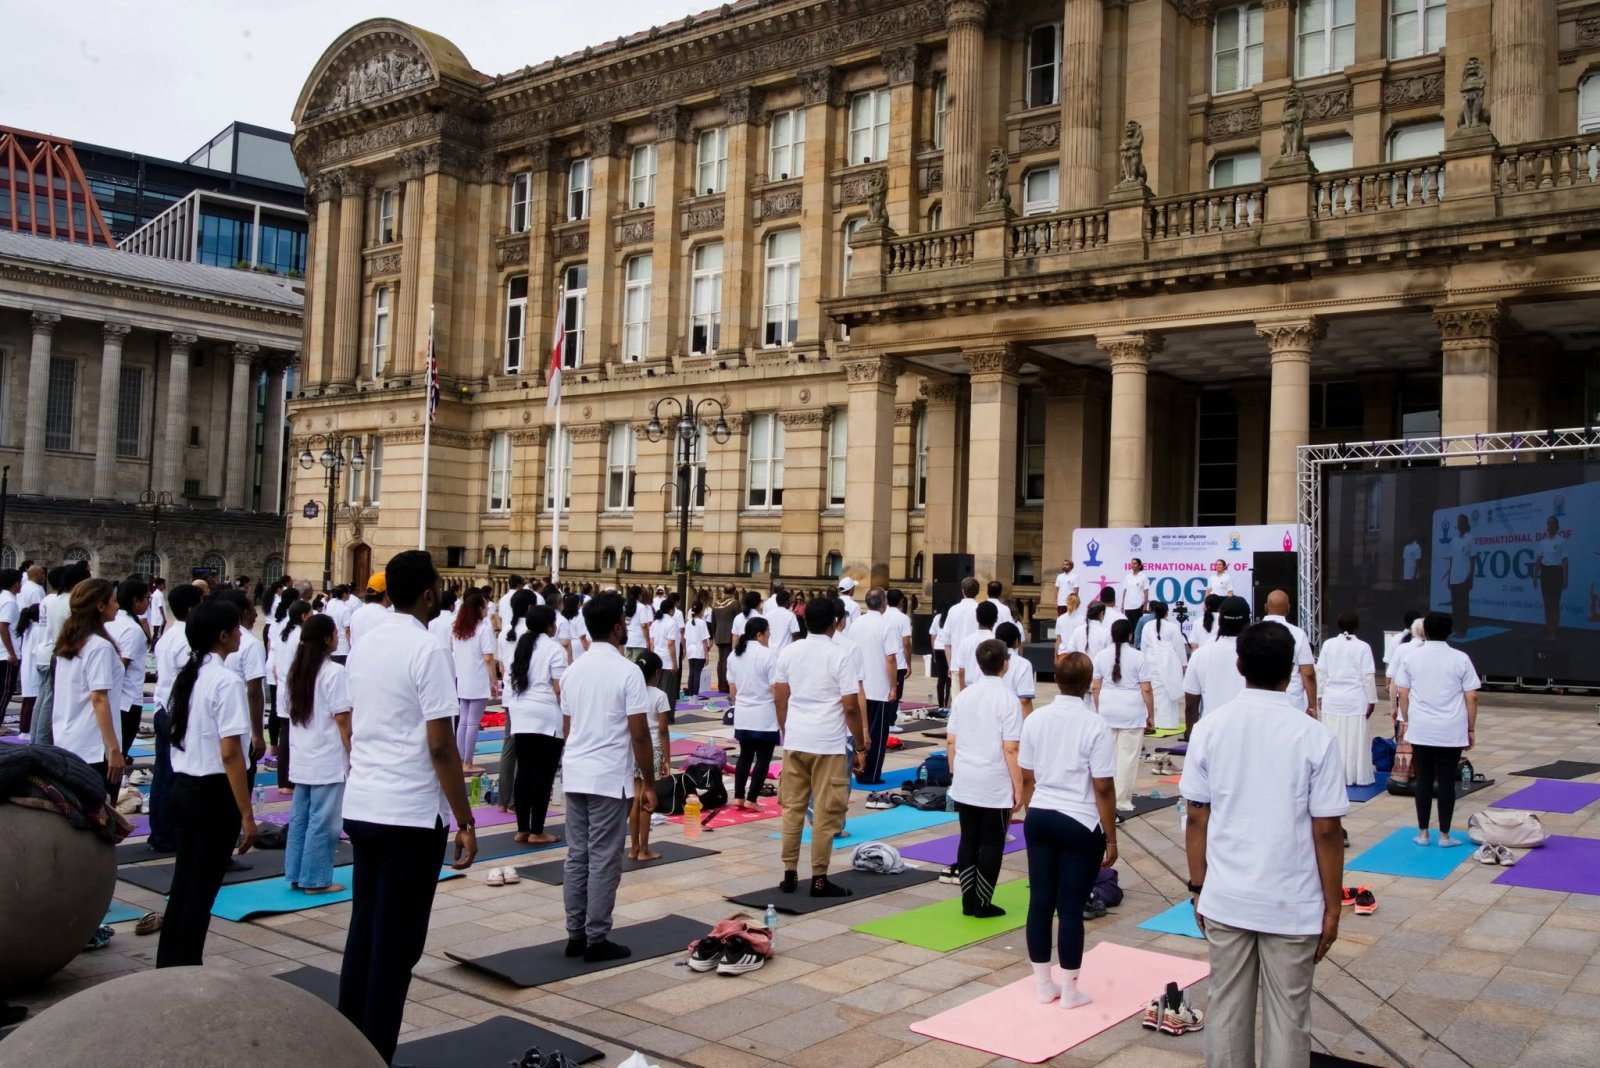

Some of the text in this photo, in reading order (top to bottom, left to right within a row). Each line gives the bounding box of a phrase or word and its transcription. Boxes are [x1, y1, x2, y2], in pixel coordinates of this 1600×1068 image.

[1210, 563, 1230, 571] DY
[1234, 563, 1248, 571] OF
[1475, 549, 1536, 579] YOG
